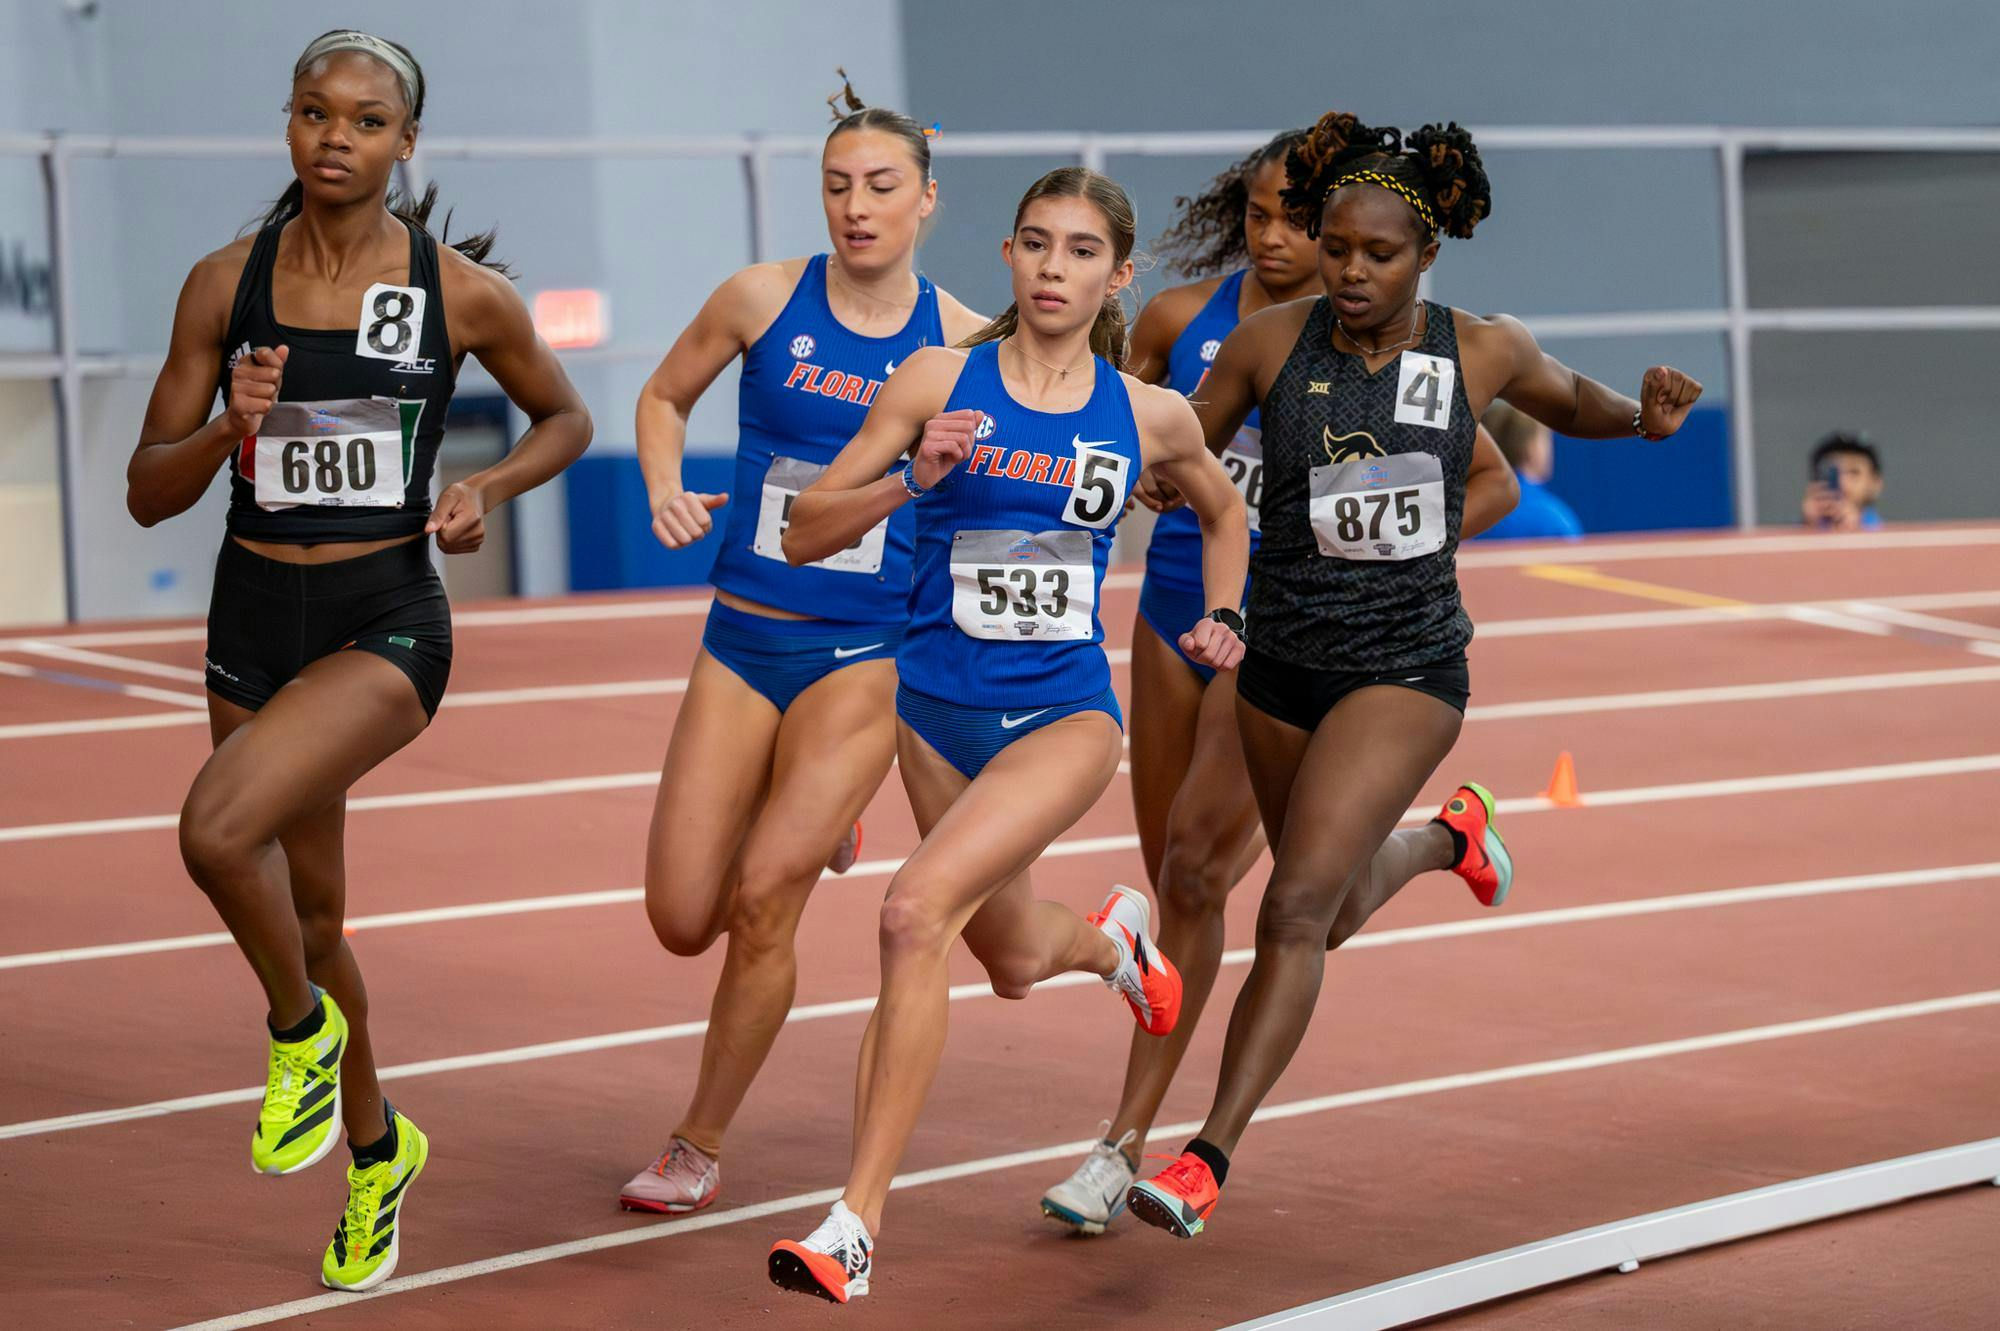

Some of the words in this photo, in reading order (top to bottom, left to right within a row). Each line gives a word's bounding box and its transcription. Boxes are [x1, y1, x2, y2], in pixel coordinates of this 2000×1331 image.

[367, 291, 414, 354] 8
[790, 335, 816, 359] SEC
[783, 361, 884, 407] FLORI
[1402, 360, 1443, 421] 4
[974, 415, 994, 438] EC
[282, 438, 376, 493] 680
[965, 444, 1077, 489] FLORI
[1074, 453, 1119, 522] 5
[1225, 457, 1262, 508] 26
[1335, 489, 1421, 542] 875
[977, 569, 1069, 618] 533
